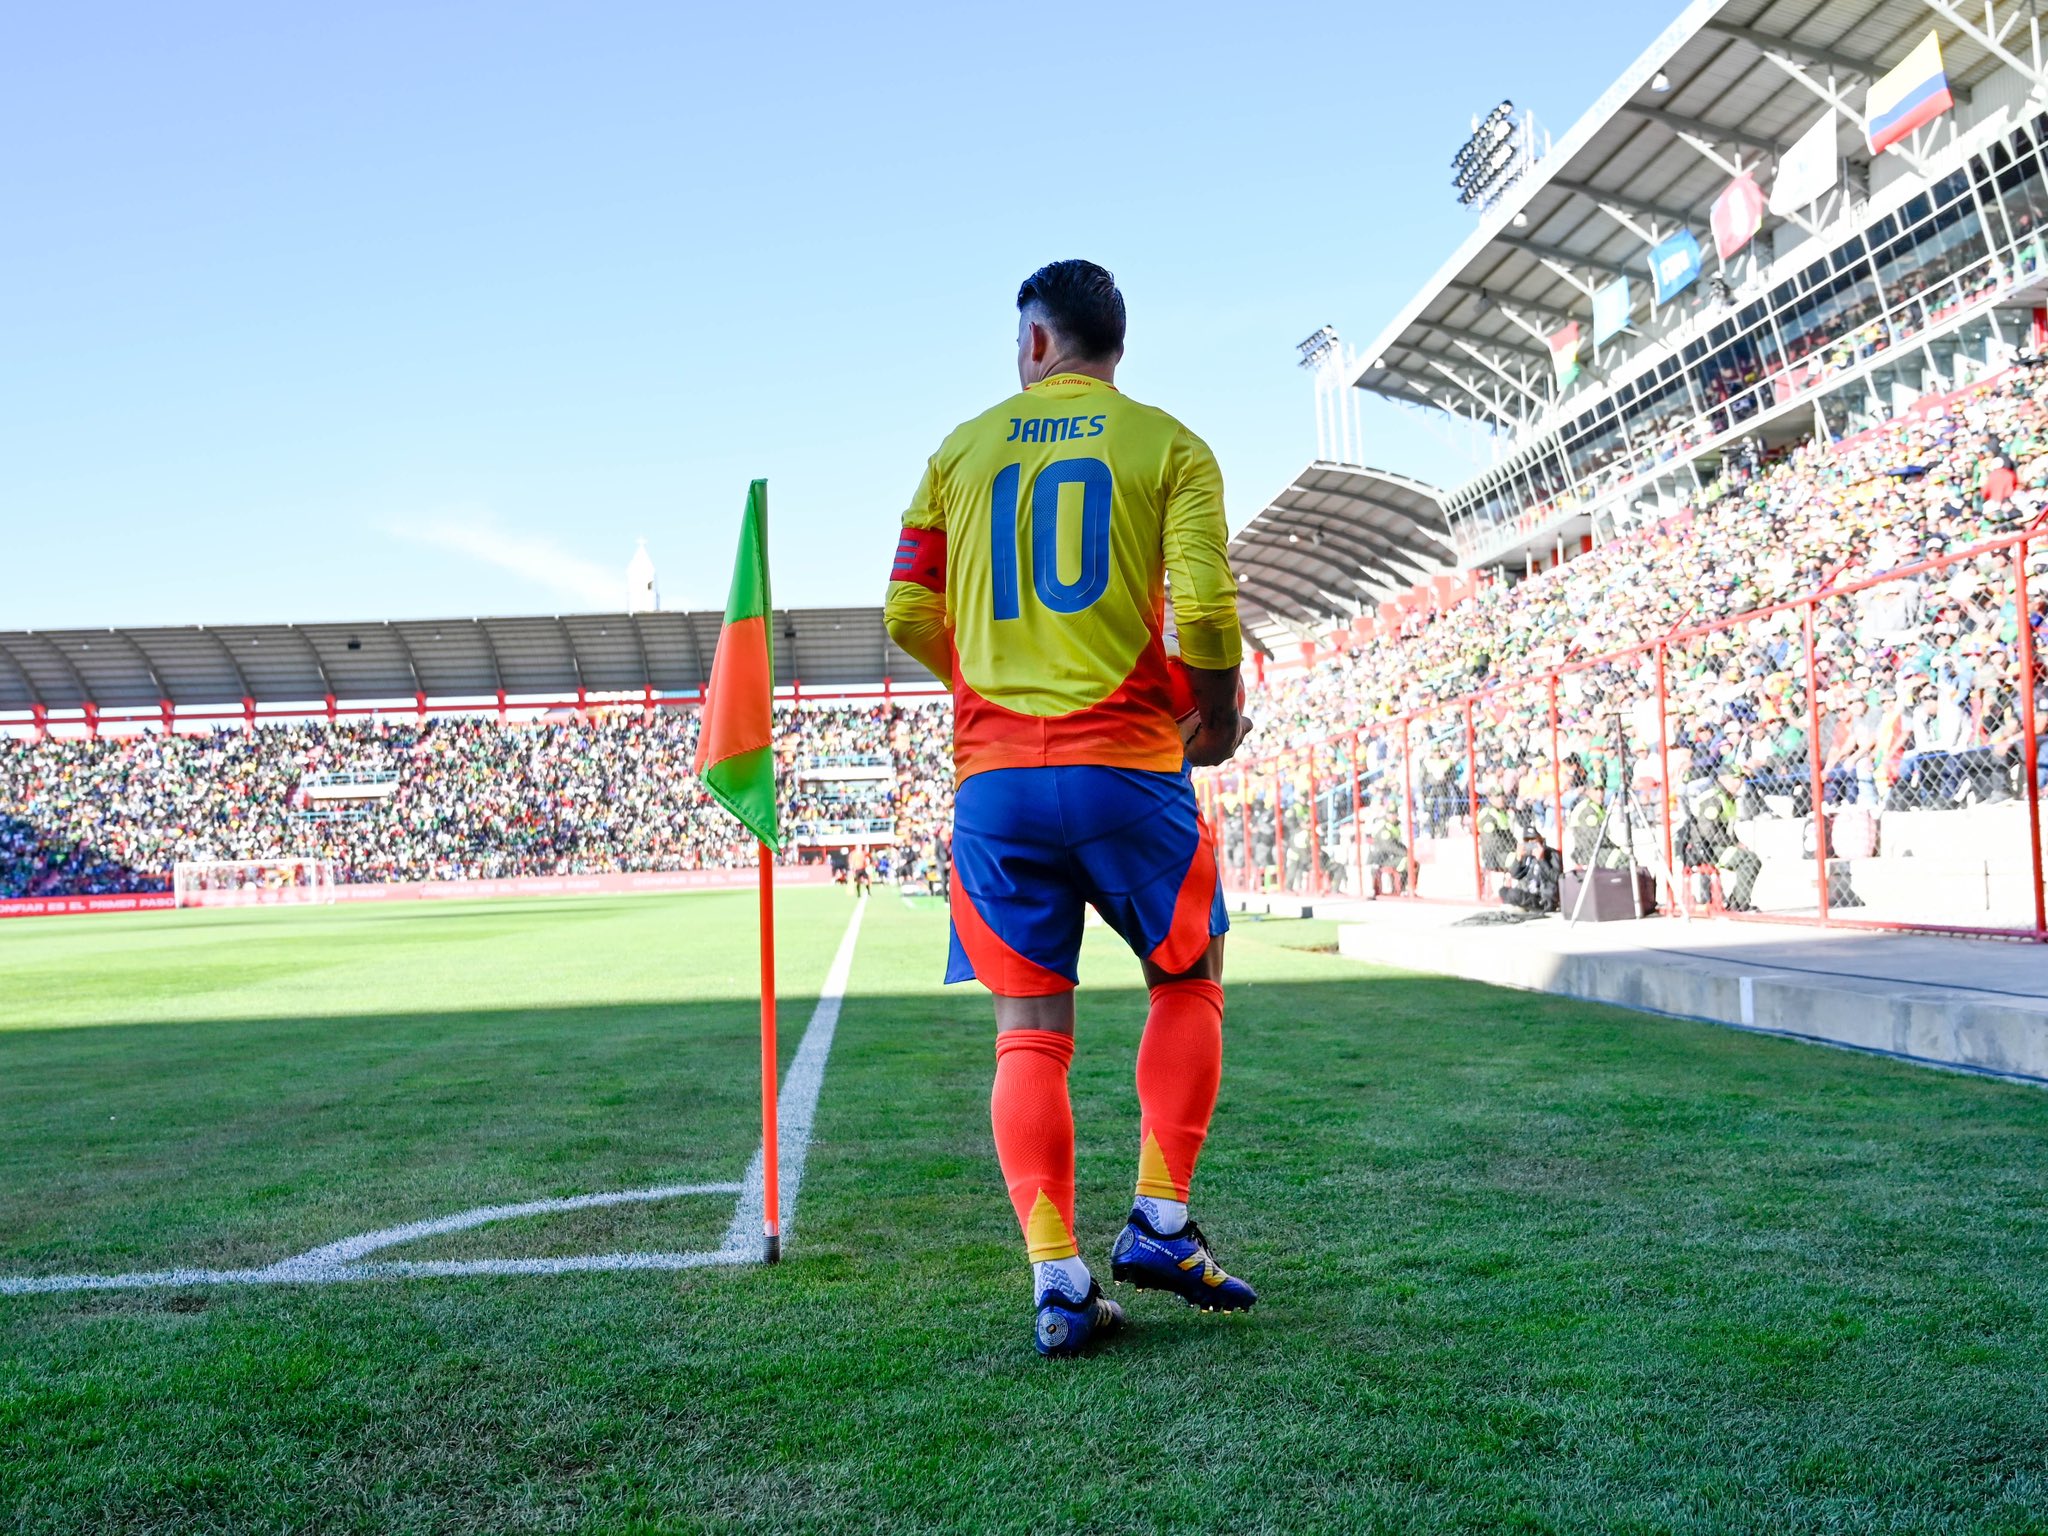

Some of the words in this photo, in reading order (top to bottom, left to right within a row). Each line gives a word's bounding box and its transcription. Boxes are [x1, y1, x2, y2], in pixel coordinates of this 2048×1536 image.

[1045, 378, 1092, 387] COLOMBIA
[1006, 415, 1107, 442] JAMES
[991, 457, 1113, 621] 10
[47, 901, 66, 912] ES
[69, 901, 86, 911] EL
[89, 899, 138, 910] PRIMER
